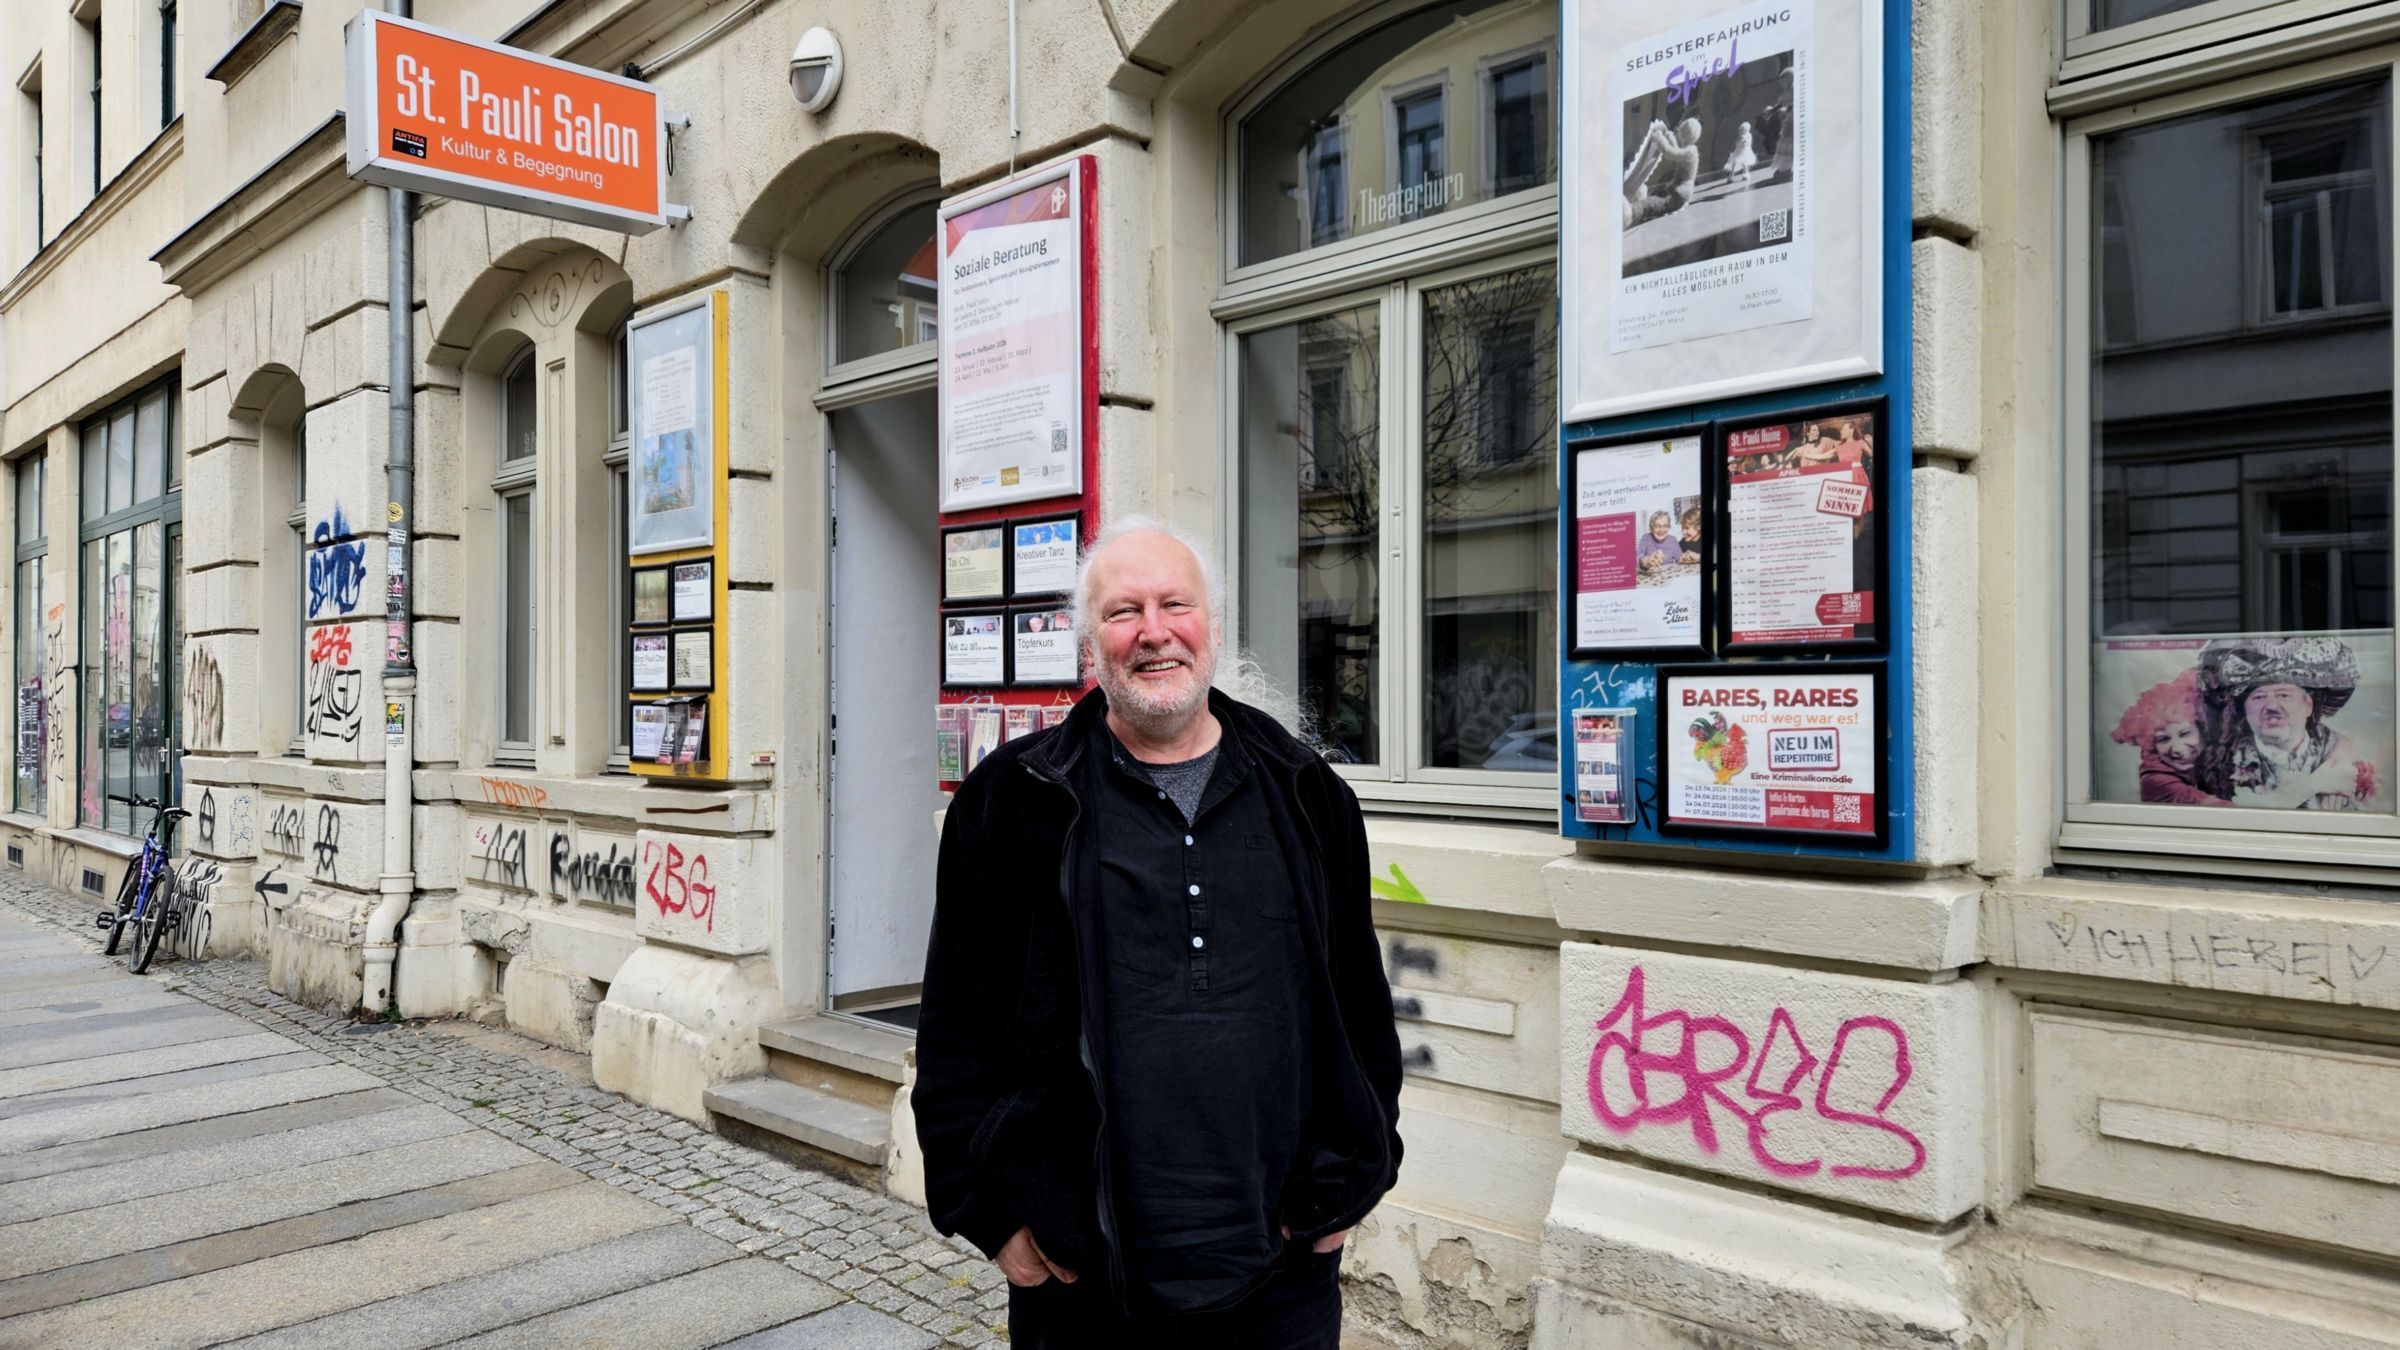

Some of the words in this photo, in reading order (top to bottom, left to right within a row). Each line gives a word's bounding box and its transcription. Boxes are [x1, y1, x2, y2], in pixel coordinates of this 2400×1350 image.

[1626, 9, 1791, 72] SELBSTERFAHRUNG
[1665, 38, 1745, 106] Spiel
[396, 54, 446, 124] St.
[460, 69, 542, 146] Pauli
[554, 93, 639, 168] Salon
[441, 135, 492, 161] Kultur
[497, 148, 508, 166] &
[514, 154, 604, 189] Begegnung
[1359, 171, 1464, 227] Theaterbüro
[954, 255, 990, 280] Soziale
[993, 238, 1047, 266] Beratung
[1625, 284, 1637, 295] EIN
[1641, 265, 1724, 291] NICHTALLTÄGLICHER
[1728, 260, 1752, 272] RAUM
[1756, 255, 1765, 266] IN
[1770, 252, 1788, 263] DEM
[1662, 286, 1687, 298] ALLES
[1690, 277, 1727, 293] MÖGLICH
[1732, 274, 1744, 284] IST
[1743, 429, 1760, 445] Pauli
[1779, 468, 1800, 477] APRIL
[1827, 485, 1862, 497] SOMMER
[1824, 499, 1859, 513] SINNE
[1016, 548, 1047, 560] Kreativer
[1049, 547, 1065, 557] Tanz
[1666, 605, 1688, 616] Leben
[1666, 614, 1689, 625] Alter
[1017, 637, 1054, 650] Töpferkurs
[1682, 688, 1767, 711] BARES,
[1774, 688, 1858, 707] RARES
[1741, 712, 1768, 724] und
[1772, 715, 1802, 726] weg
[1806, 714, 1832, 725] war
[1837, 713, 1859, 725] es!
[1774, 736, 1808, 751] NEU
[1813, 735, 1833, 750] IM
[1774, 753, 1834, 764] REPERTOIRE
[1750, 772, 1770, 781] Eine
[1772, 773, 1854, 784] Kriminalkomödie
[2087, 926, 2154, 967] ICH
